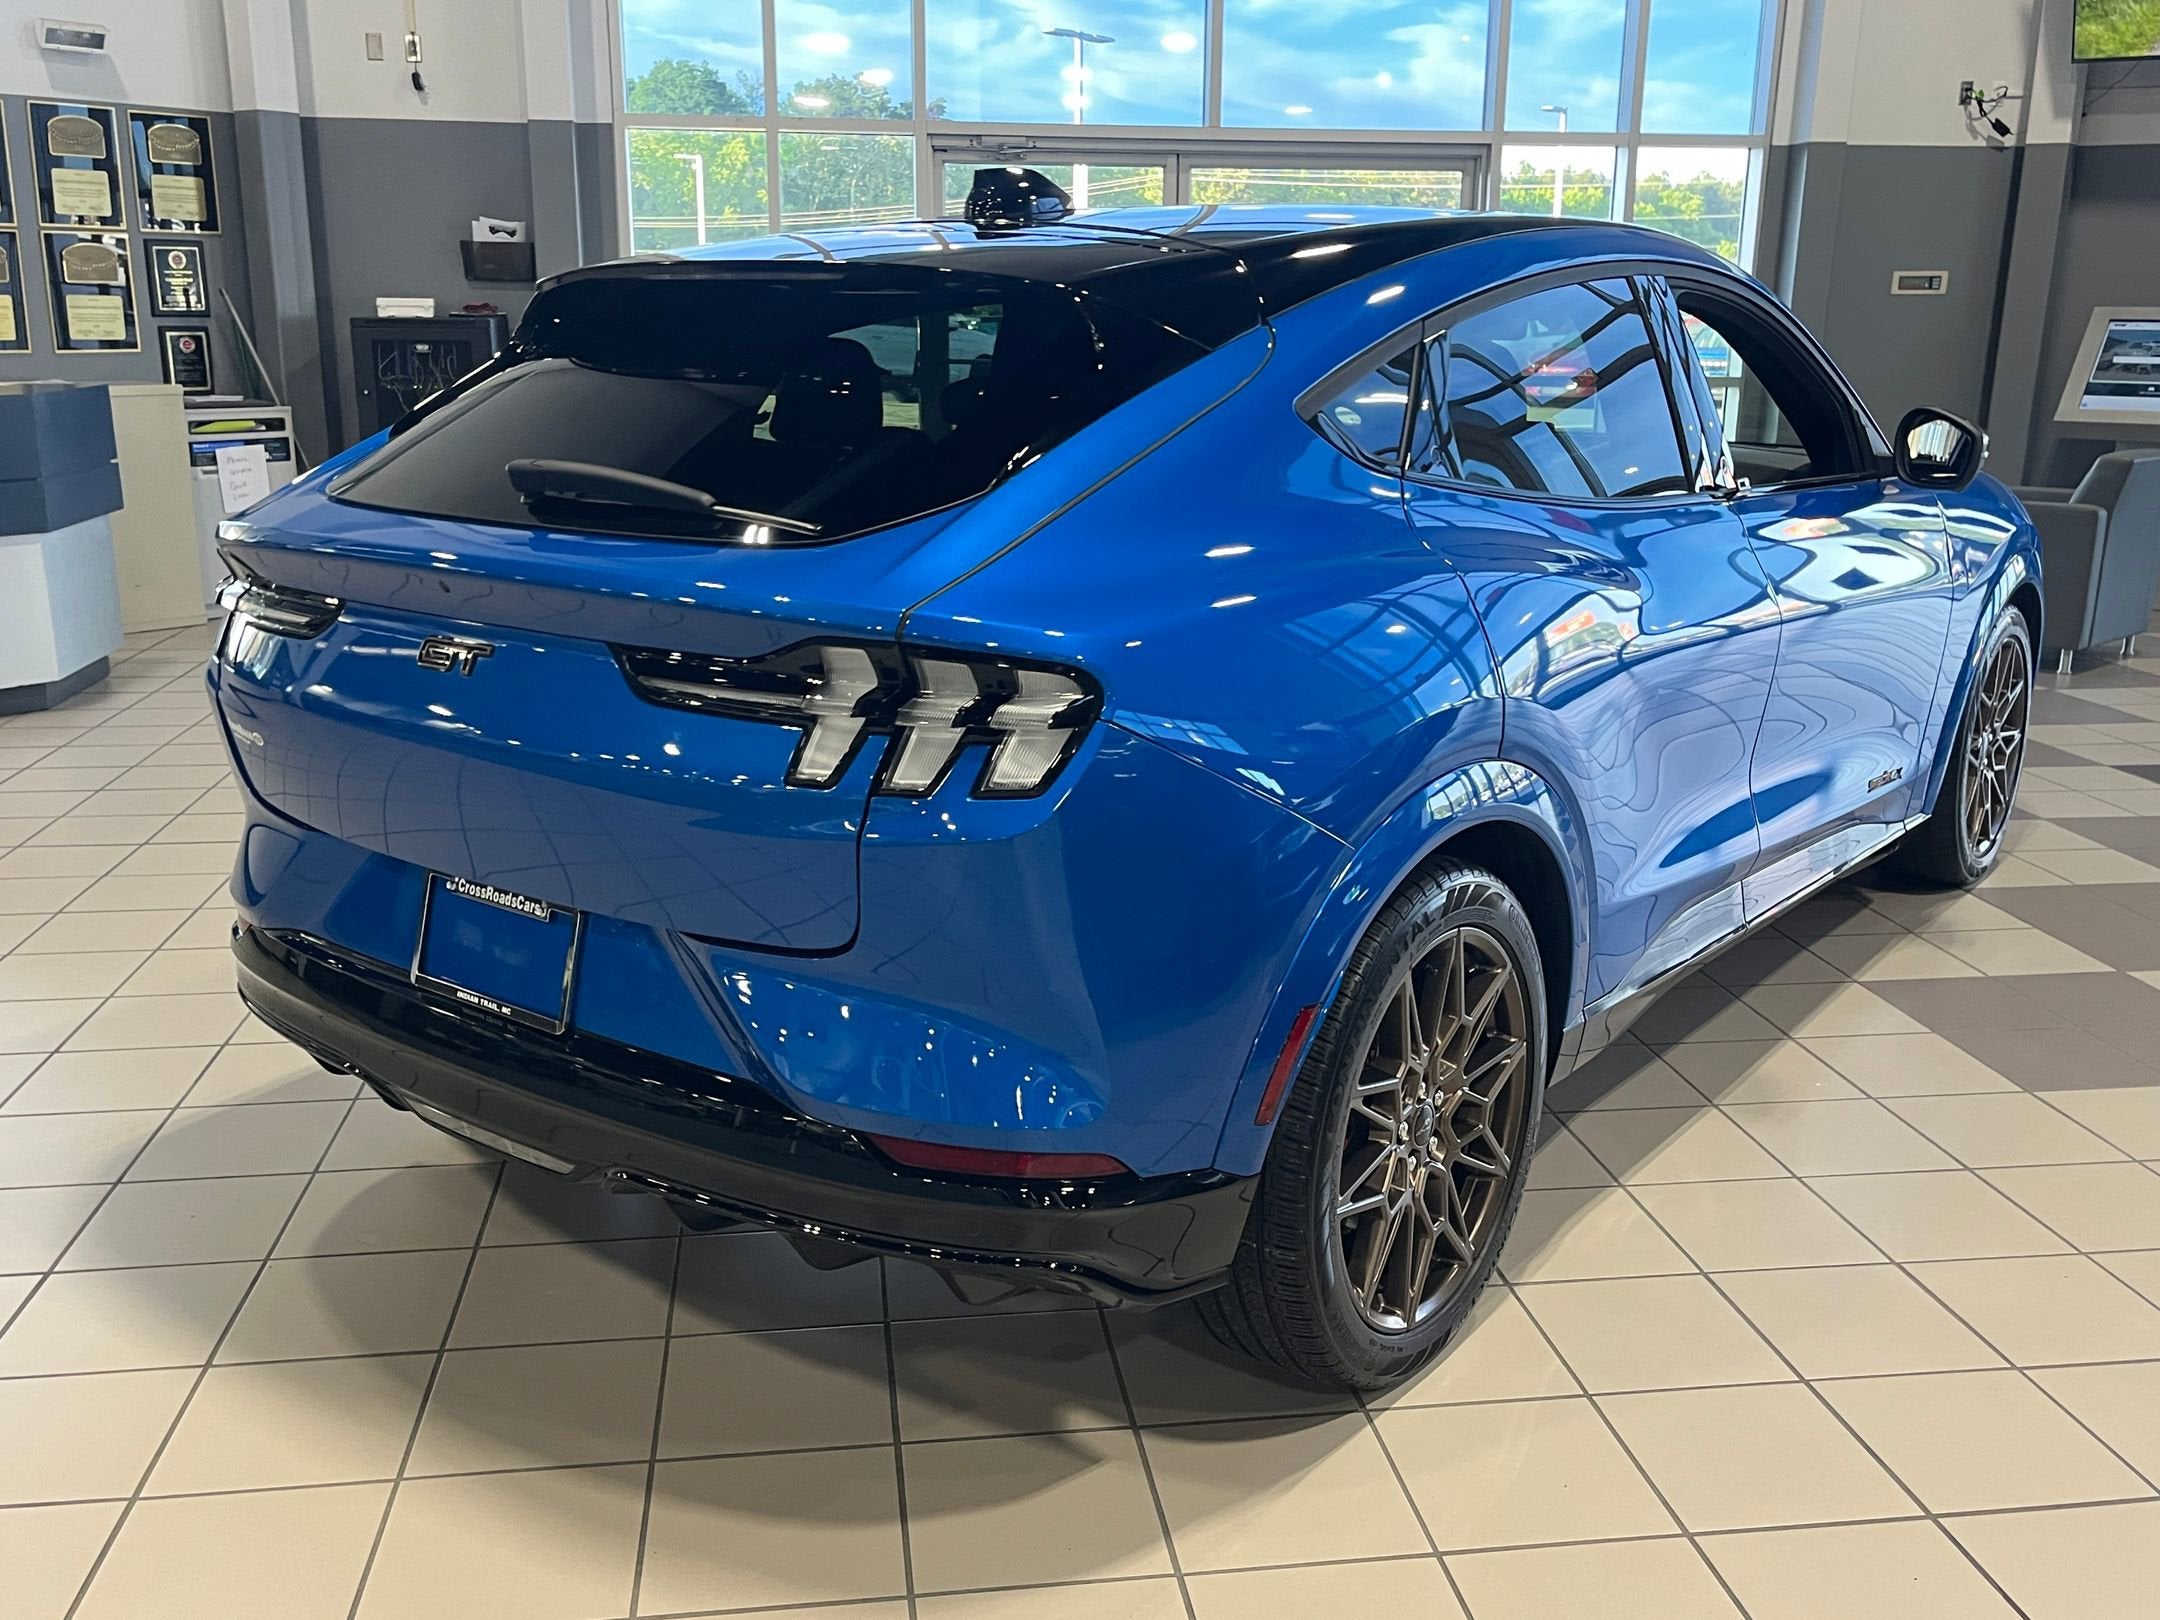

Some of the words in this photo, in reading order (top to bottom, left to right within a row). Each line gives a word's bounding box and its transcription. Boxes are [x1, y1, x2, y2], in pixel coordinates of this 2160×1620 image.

[416, 634, 495, 677] GT
[458, 878, 543, 916] CrossRoadsCars
[456, 990, 479, 1004] INDIAN
[501, 1006, 512, 1015] NC
